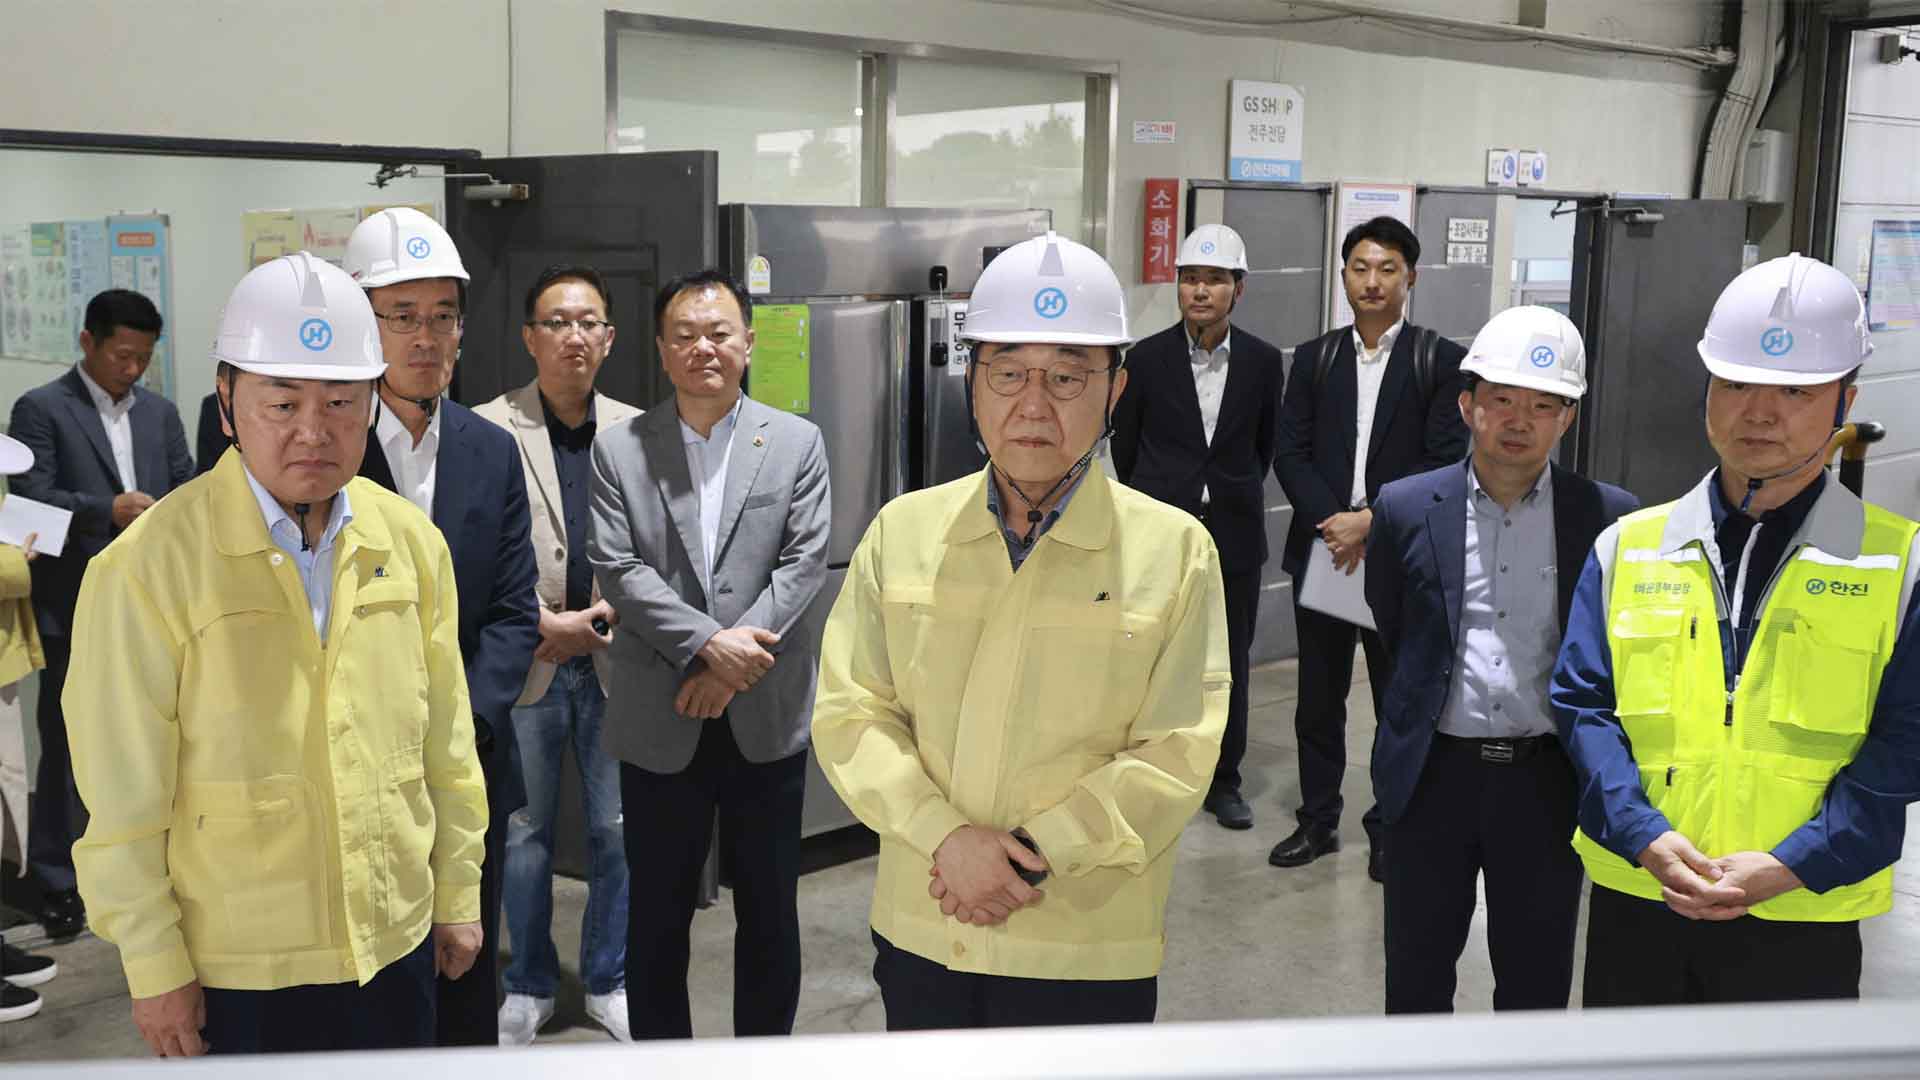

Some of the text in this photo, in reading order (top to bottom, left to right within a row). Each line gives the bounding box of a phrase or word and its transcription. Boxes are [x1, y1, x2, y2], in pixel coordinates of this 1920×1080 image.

[1243, 96, 1259, 113] GS
[1150, 188, 1172, 267] 소화기
[1830, 581, 1869, 596] 한진
